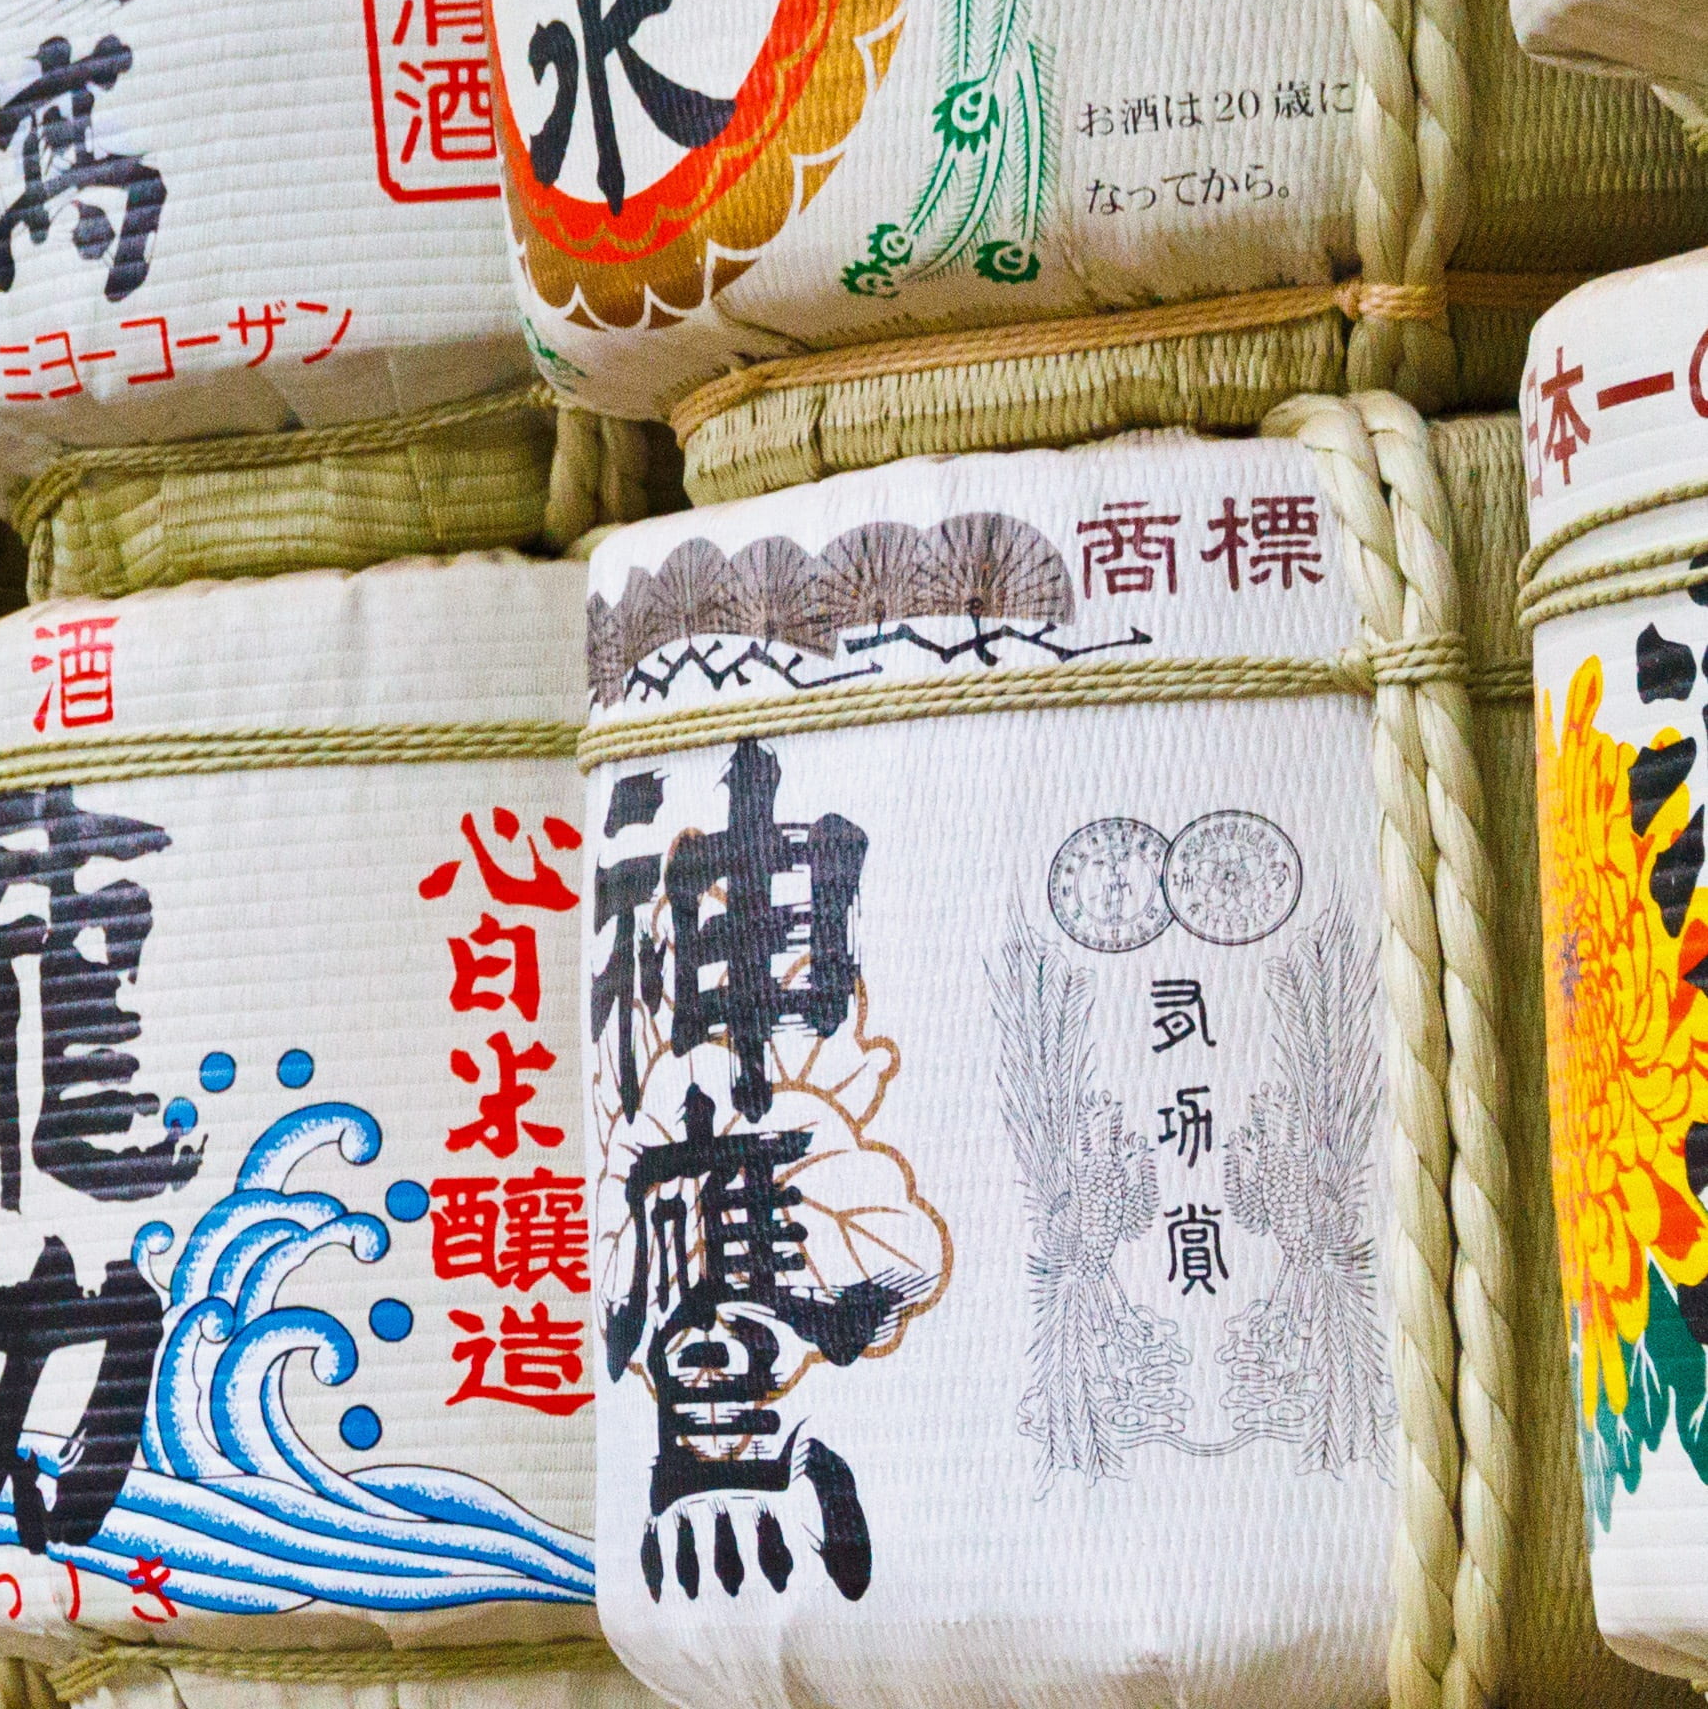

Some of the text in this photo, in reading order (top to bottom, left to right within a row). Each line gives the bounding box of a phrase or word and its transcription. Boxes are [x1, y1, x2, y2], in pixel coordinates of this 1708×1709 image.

[1083, 164, 1292, 216] なってから。
[0, 302, 352, 402] ミョーコーザン
[1076, 498, 1326, 600] 商標
[589, 740, 918, 1603] 神鷹
